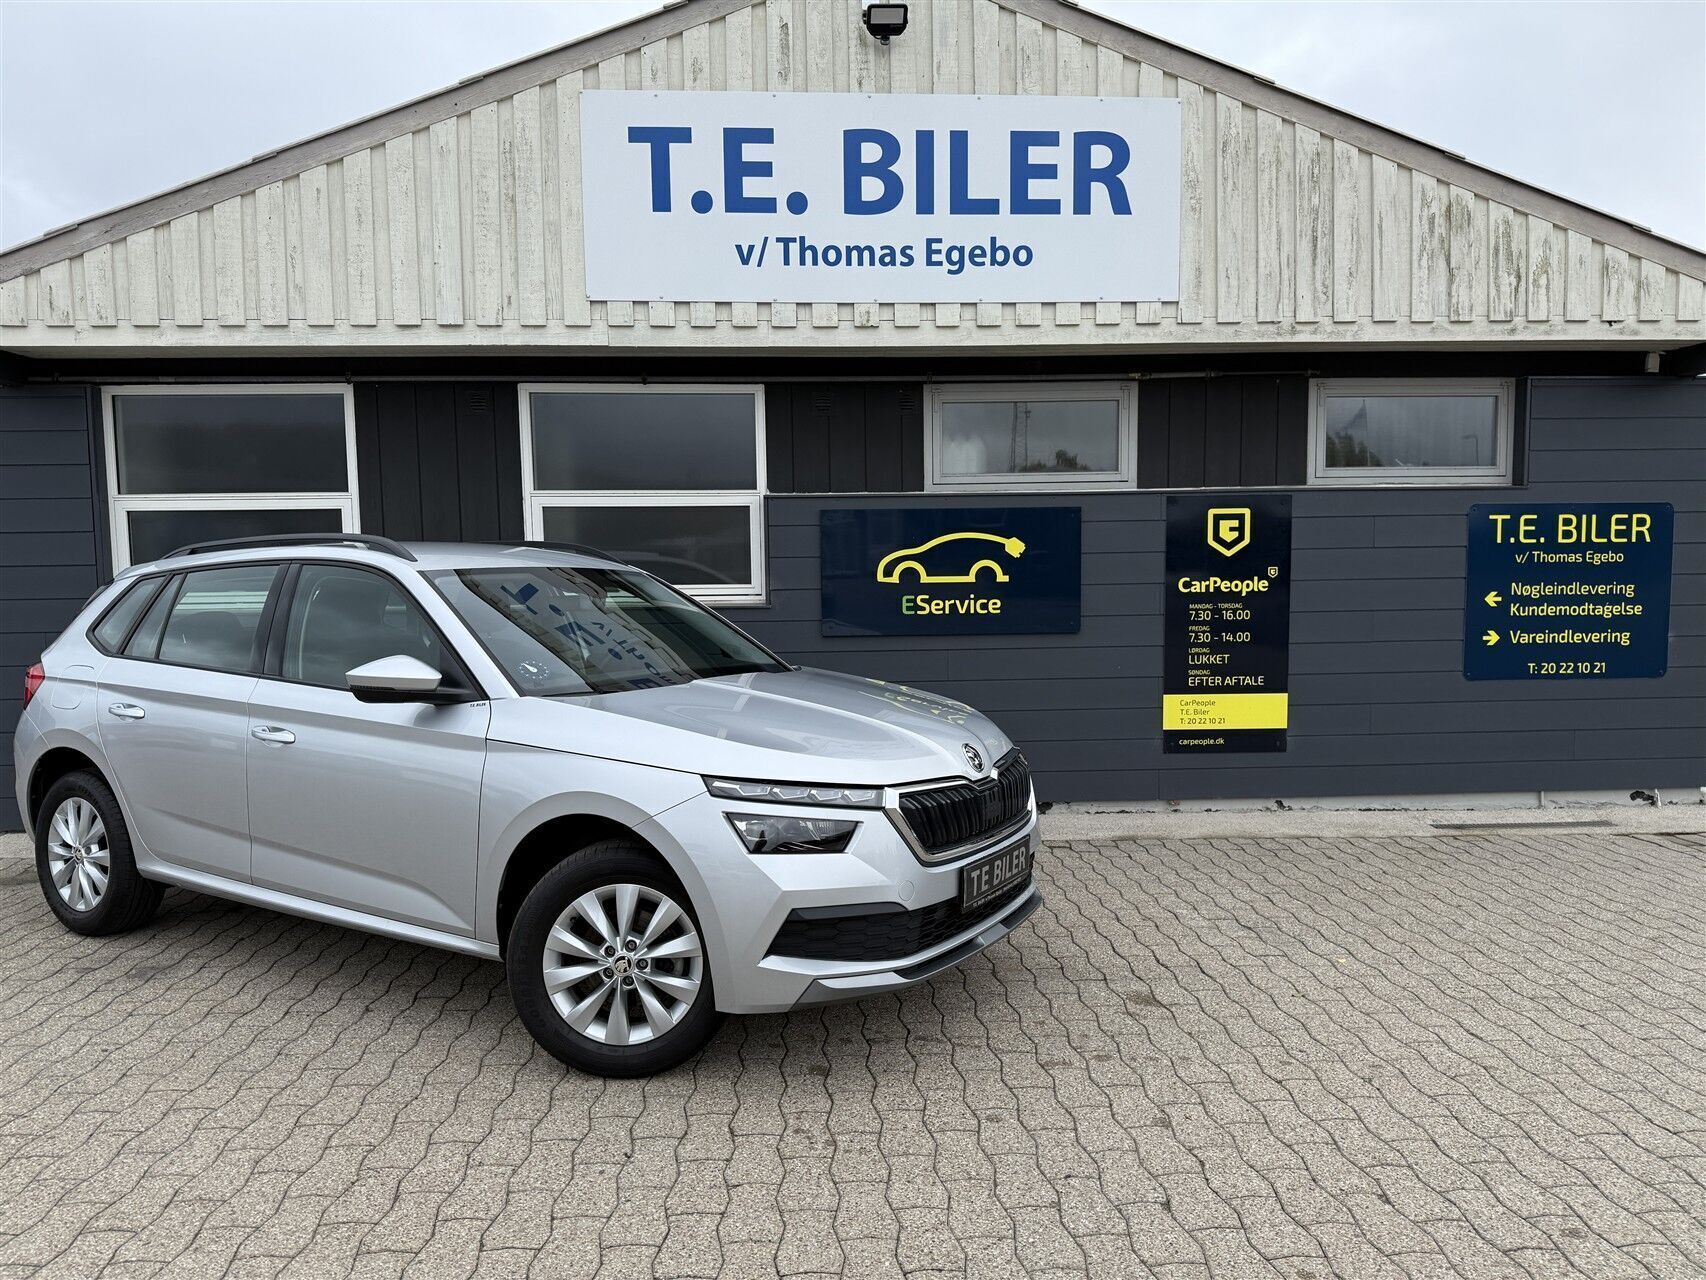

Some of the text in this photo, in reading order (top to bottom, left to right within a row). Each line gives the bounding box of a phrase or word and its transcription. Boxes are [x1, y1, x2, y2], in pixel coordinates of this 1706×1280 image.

[628, 126, 1133, 215] T.E. BILER
[735, 236, 1034, 275] v/ Thomas Egebo
[1489, 513, 1651, 544] T.E. BILER
[1515, 550, 1625, 565] v/ Thomas Egebo
[1178, 576, 1269, 596] CarPeople
[1511, 581, 1635, 598] Nøgleindlevering
[902, 594, 1002, 615] EService
[1510, 602, 1643, 618] Kundemodtagelse
[1189, 610, 1211, 620] 7.30
[1222, 609, 1251, 620] 16.00
[1189, 632, 1211, 643] 7.30
[1221, 632, 1251, 642] 14.00
[1510, 629, 1631, 646] Vareindlevering
[1188, 654, 1230, 664] LUKKET
[1527, 662, 1606, 674] T: 20 22 10 21
[1188, 676, 1265, 686] EFTER AFTALE
[1179, 699, 1216, 707] CarPeople
[1178, 737, 1225, 746] carpeople.dk
[993, 846, 1026, 886] BILER
